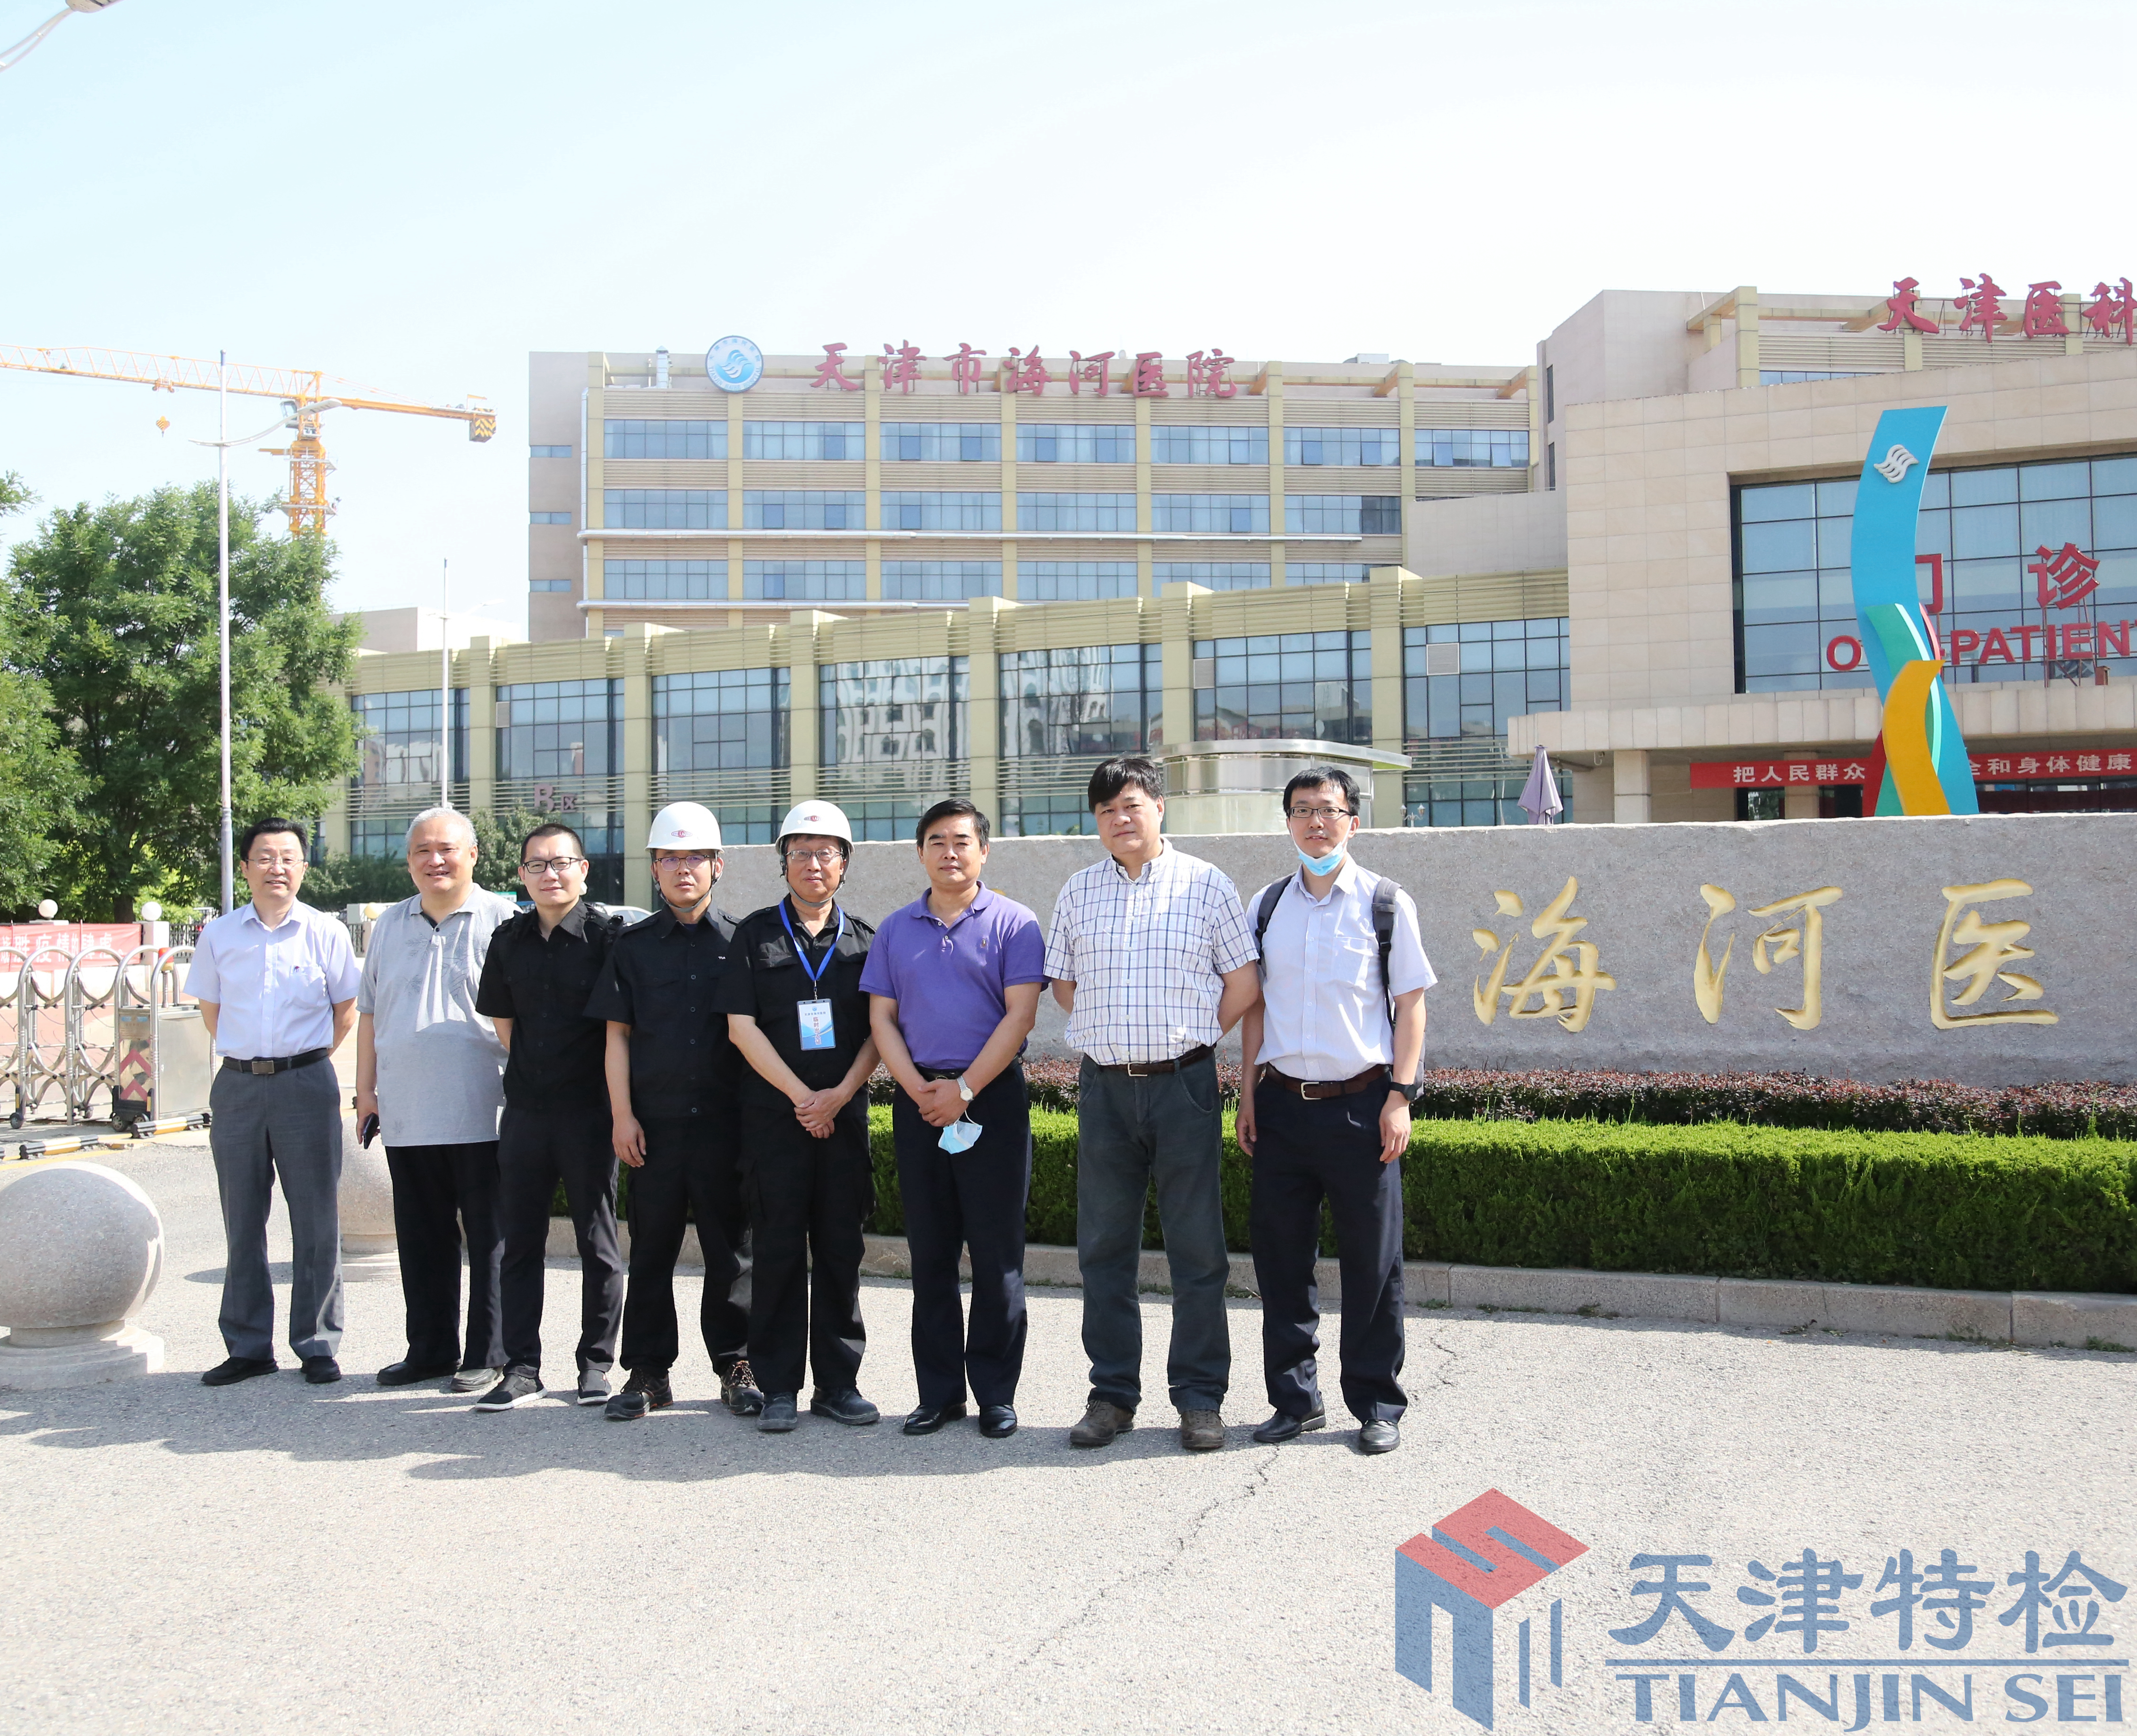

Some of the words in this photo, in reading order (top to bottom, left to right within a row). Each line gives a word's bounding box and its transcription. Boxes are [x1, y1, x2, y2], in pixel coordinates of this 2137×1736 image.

[1877, 273, 2137, 346] 天津医科
[810, 339, 1237, 398] 天津市海河医院
[534, 783, 577, 813] B区
[1472, 876, 2059, 1032] 海河医
[813, 1016, 822, 1045] 临时出入证
